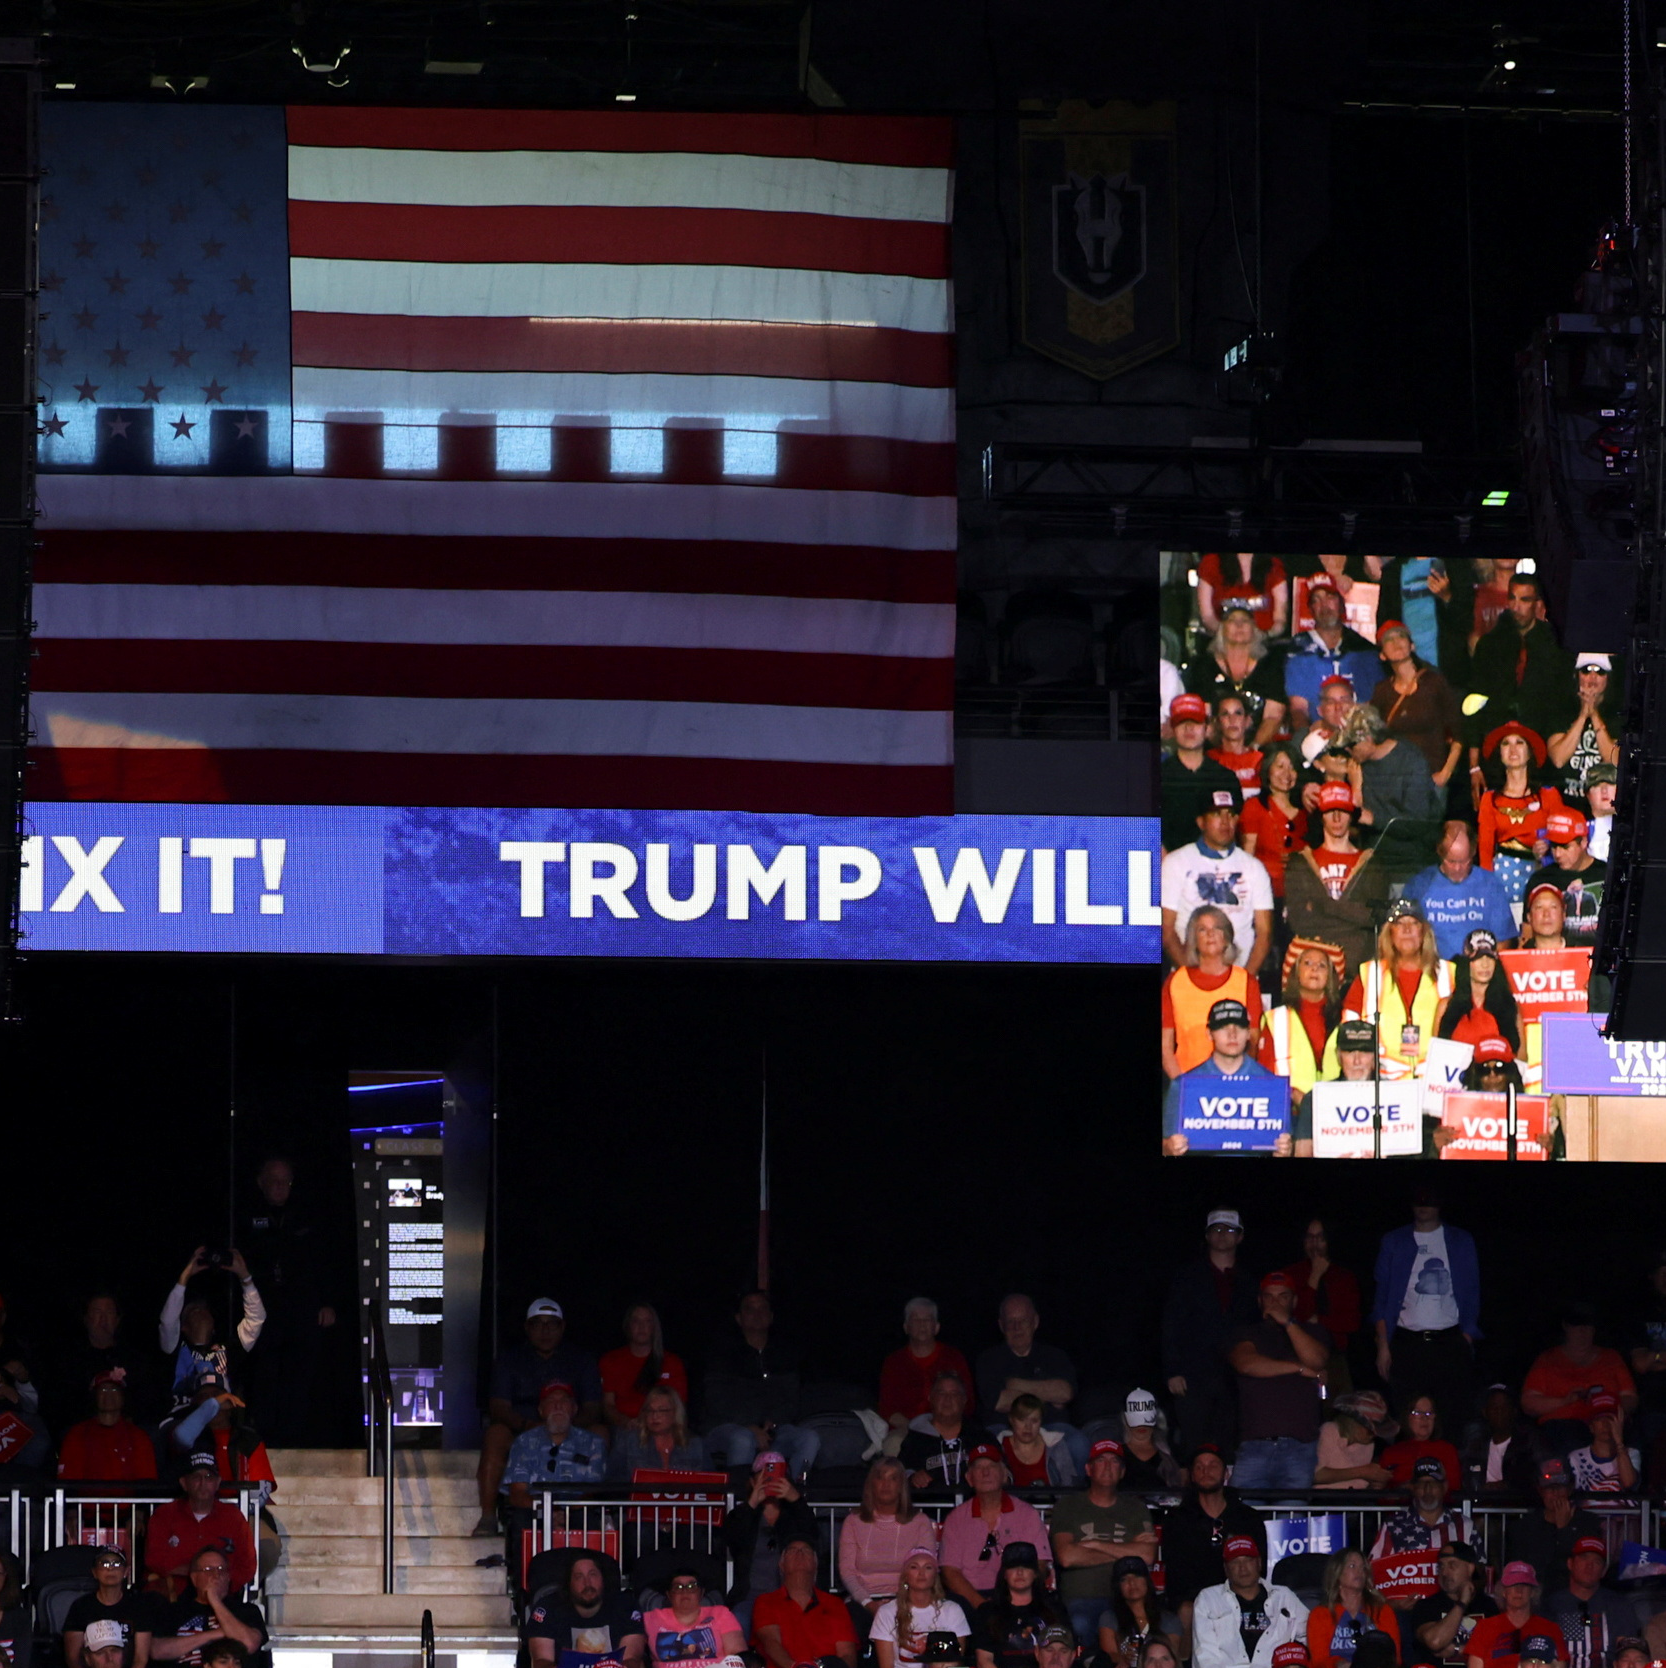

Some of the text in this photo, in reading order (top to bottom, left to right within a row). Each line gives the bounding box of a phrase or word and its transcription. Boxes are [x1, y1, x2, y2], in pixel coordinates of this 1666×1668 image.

[21, 836, 286, 915] IX IT!
[500, 841, 1161, 926] TRUMP WILL
[1512, 969, 1576, 991] VOTE
[1199, 1096, 1270, 1117] VOTE
[1183, 1117, 1283, 1130] NOVEMBER 5TH
[1392, 1122, 1416, 1134] 5TH
[1128, 1400, 1157, 1413] TRUMP
[1273, 1536, 1332, 1556] VOTE
[1375, 1577, 1437, 1591] NOVEMBER
